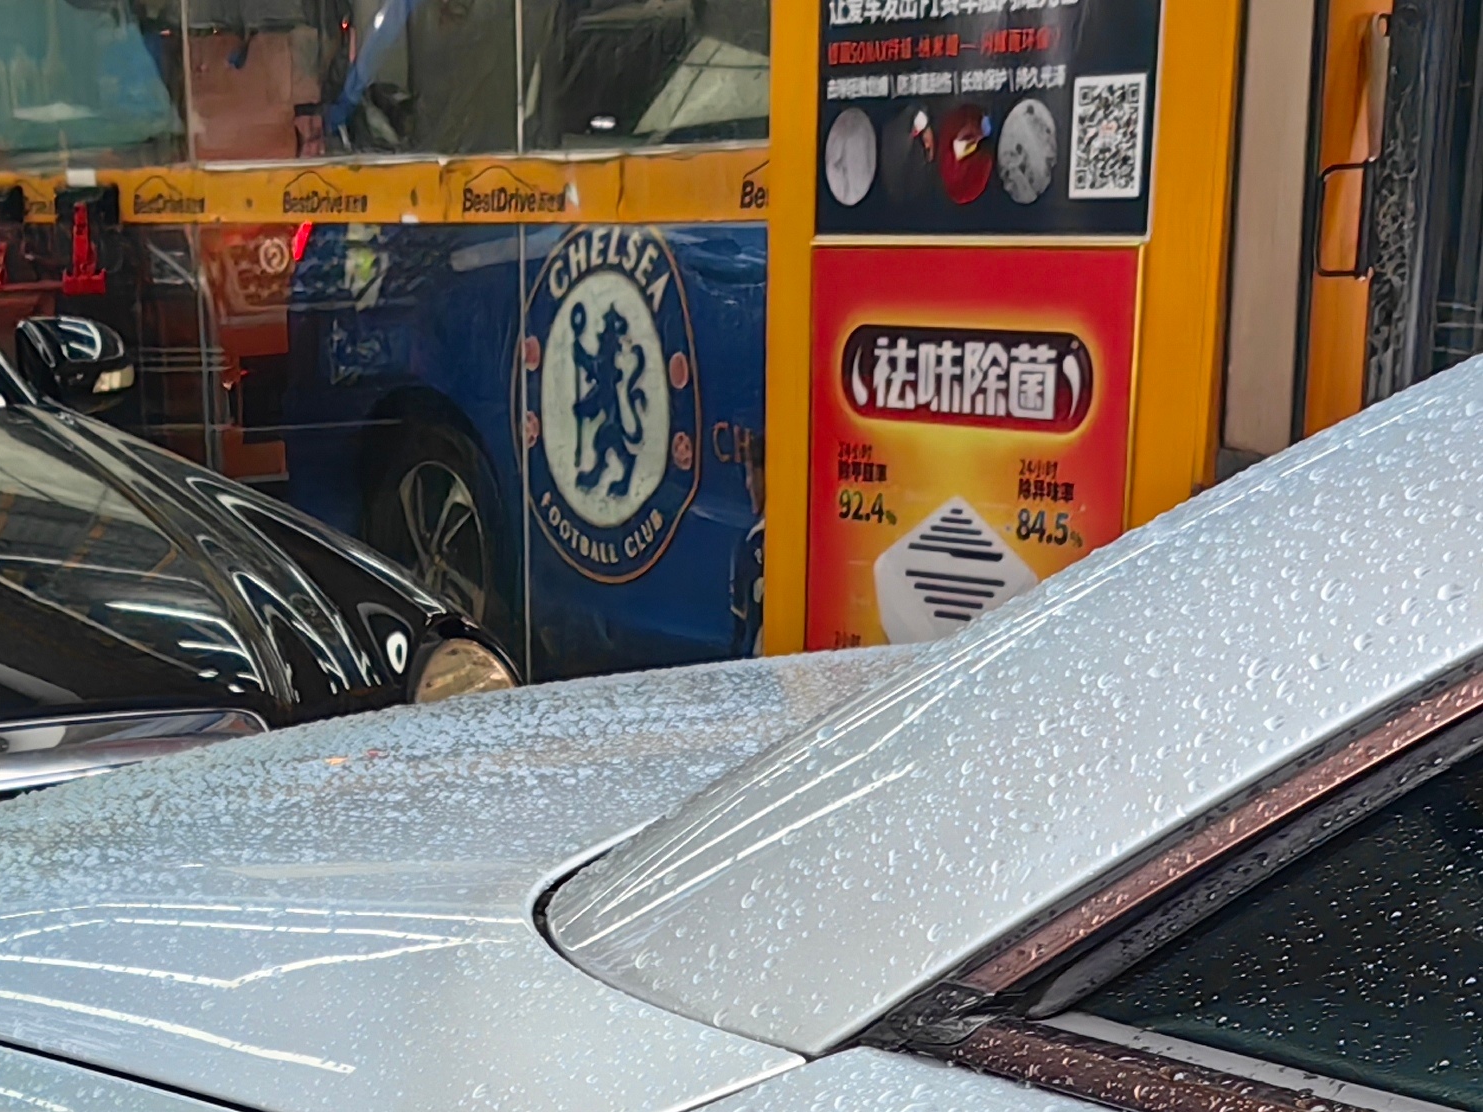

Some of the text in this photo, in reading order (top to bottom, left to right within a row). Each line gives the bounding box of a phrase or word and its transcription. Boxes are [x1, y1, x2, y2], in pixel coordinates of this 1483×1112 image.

[548, 226, 671, 313] CHELSEA
[873, 337, 1058, 421] 祛味除菌
[1017, 478, 1076, 503] 除异味率
[1018, 459, 1059, 480] 24小时
[624, 508, 665, 560] CLUB
